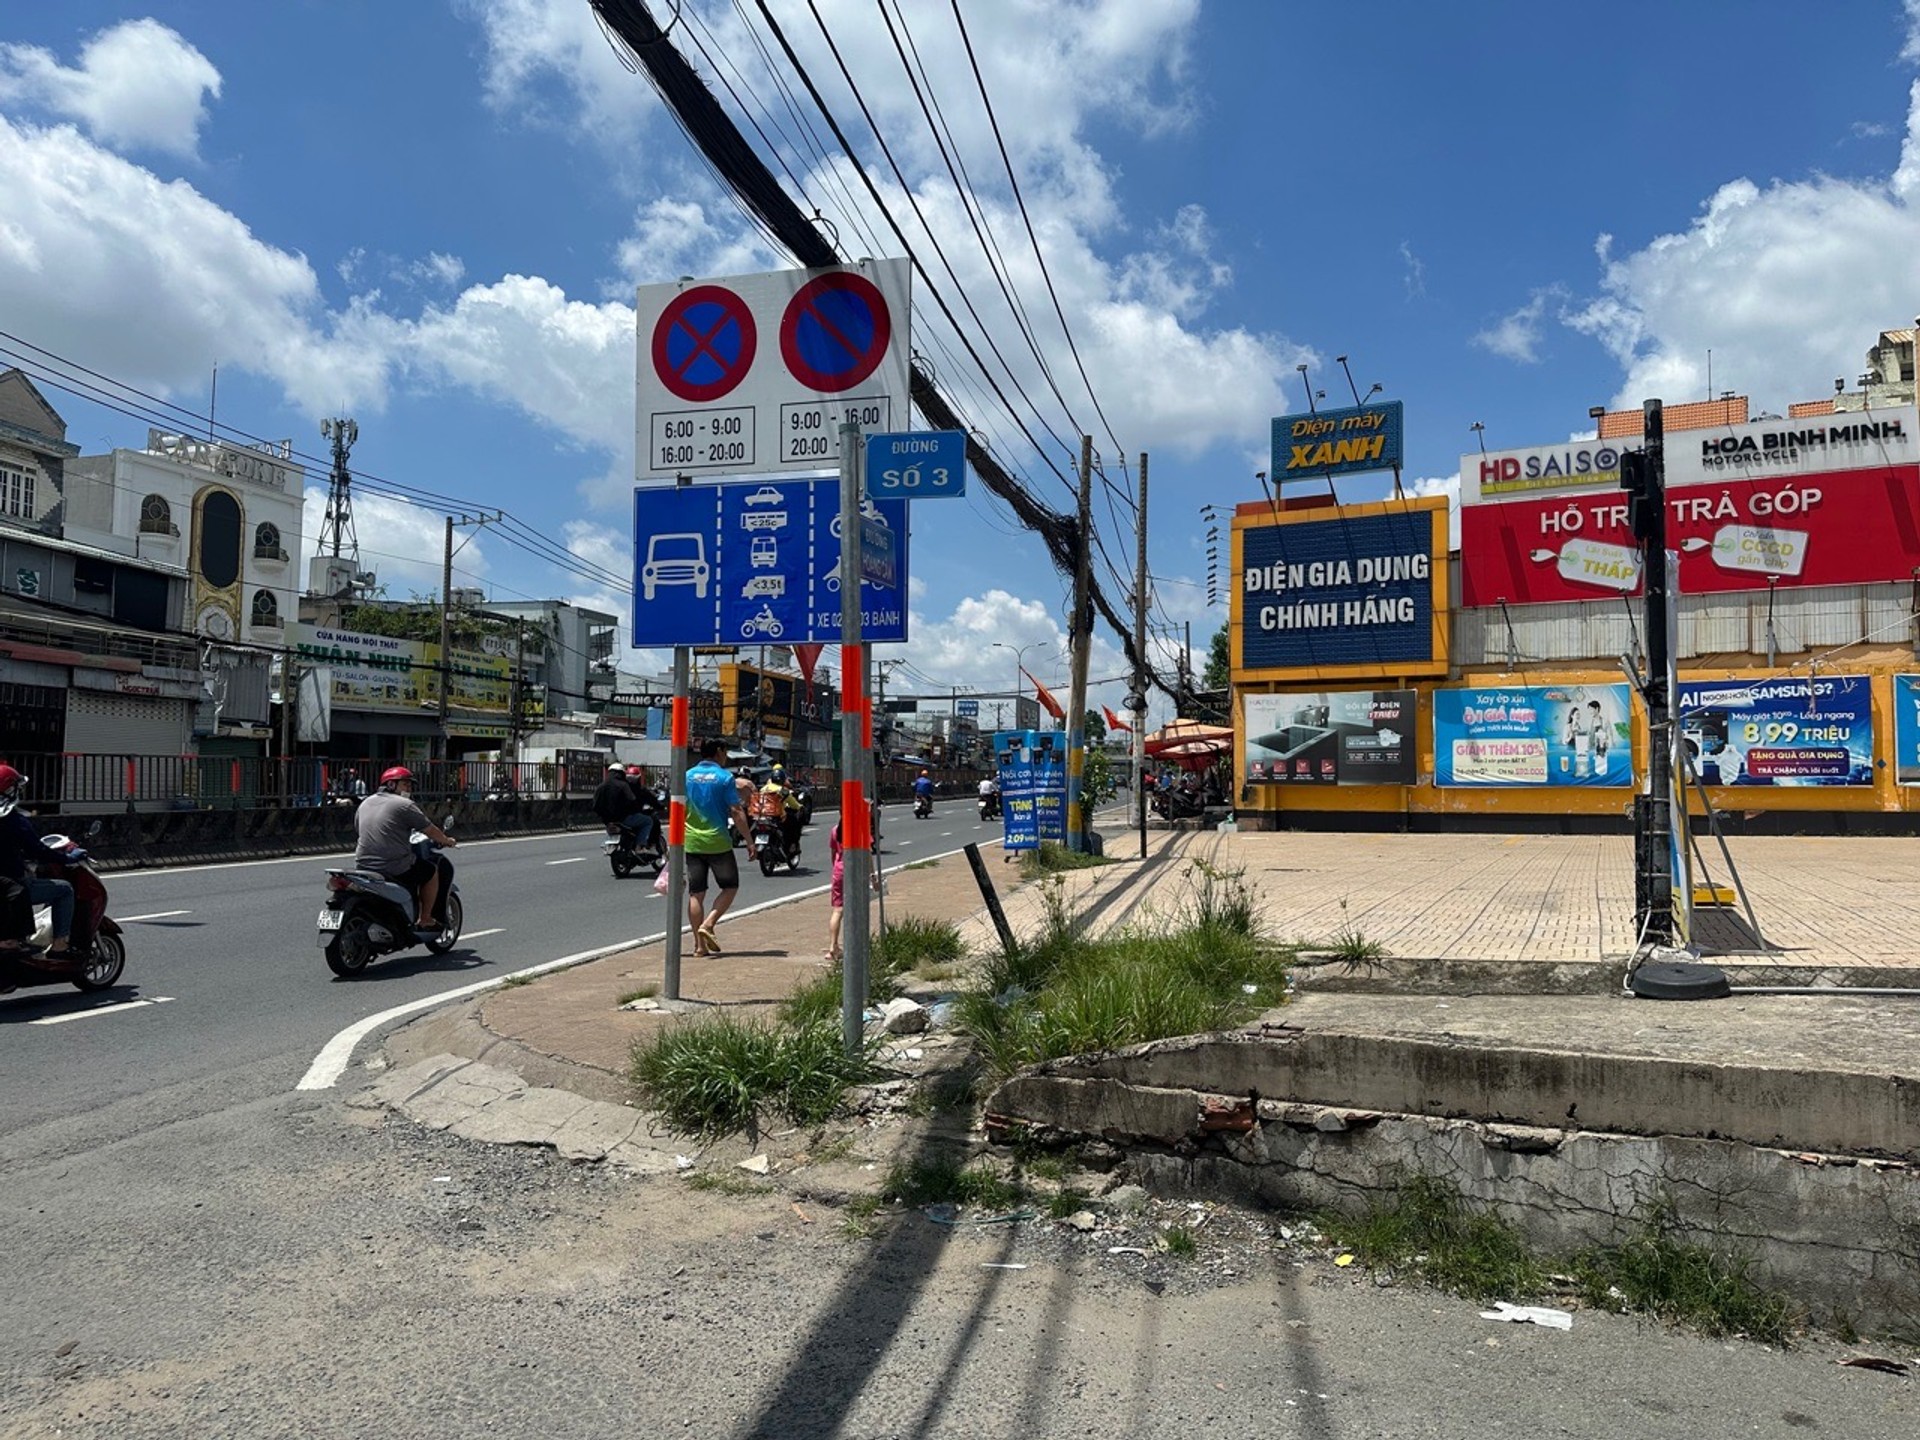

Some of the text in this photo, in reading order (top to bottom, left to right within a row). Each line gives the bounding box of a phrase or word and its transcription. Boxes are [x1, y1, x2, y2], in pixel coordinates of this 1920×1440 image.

[665, 420, 694, 439] 6:00
[712, 417, 741, 435] 9:00
[791, 411, 821, 430] 9:00
[845, 406, 880, 425] 16:00
[1292, 412, 1385, 437] Điện máy
[661, 445, 694, 464] 16:00
[709, 442, 745, 461] 20:00
[791, 437, 827, 456] 20:00
[891, 437, 939, 455] ĐƯỜNG
[1287, 434, 1385, 469] XANH
[1702, 448, 1798, 466] MOTORCYCLE
[882, 461, 949, 488] SỐ 3
[1540, 483, 1822, 534] HỖ TR TRẢ GÓP
[1741, 538, 1794, 556] CCCD
[1245, 553, 1429, 595] ĐIỆN GIA DỤNG
[1583, 558, 1635, 579] THẤP
[817, 613, 829, 628] XE
[872, 607, 900, 626] BÁNH
[1260, 594, 1415, 631] CHÍNH HÃNG
[1680, 691, 1698, 708] AI
[1750, 683, 1833, 700] SAMSUNG?
[1732, 713, 1751, 722] Máy
[1824, 712, 1855, 721] ngang
[1744, 723, 1850, 746] 8,99 TRIỆU
[1456, 741, 1486, 756] GIẢM
[1488, 741, 1519, 755] THÊM
[1799, 751, 1815, 759] GIA
